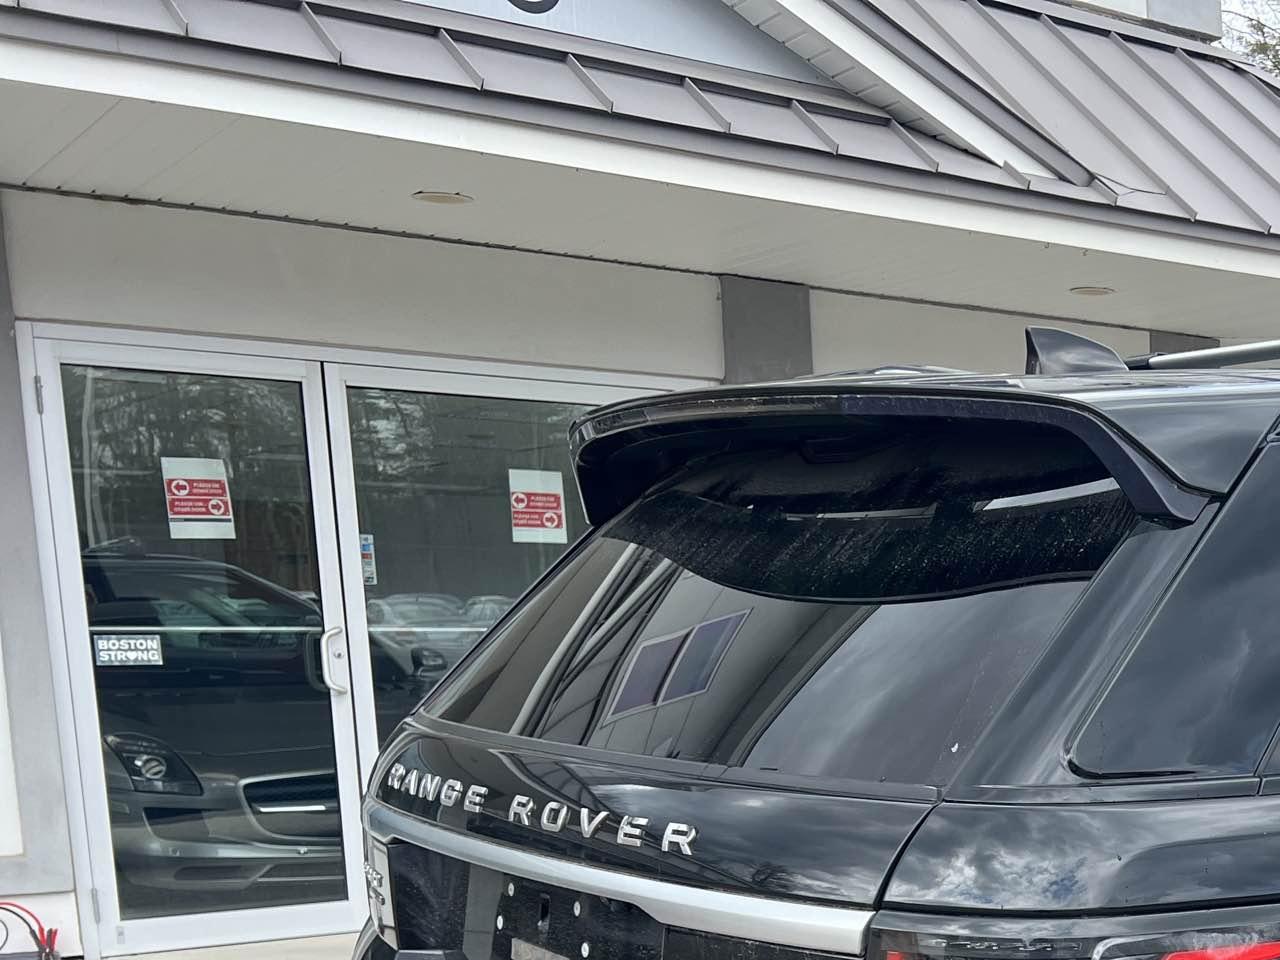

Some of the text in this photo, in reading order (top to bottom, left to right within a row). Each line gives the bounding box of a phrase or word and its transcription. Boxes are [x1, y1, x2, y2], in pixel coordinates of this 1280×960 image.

[97, 639, 158, 650] BOSTON
[387, 763, 697, 855] RANGE ROVER
